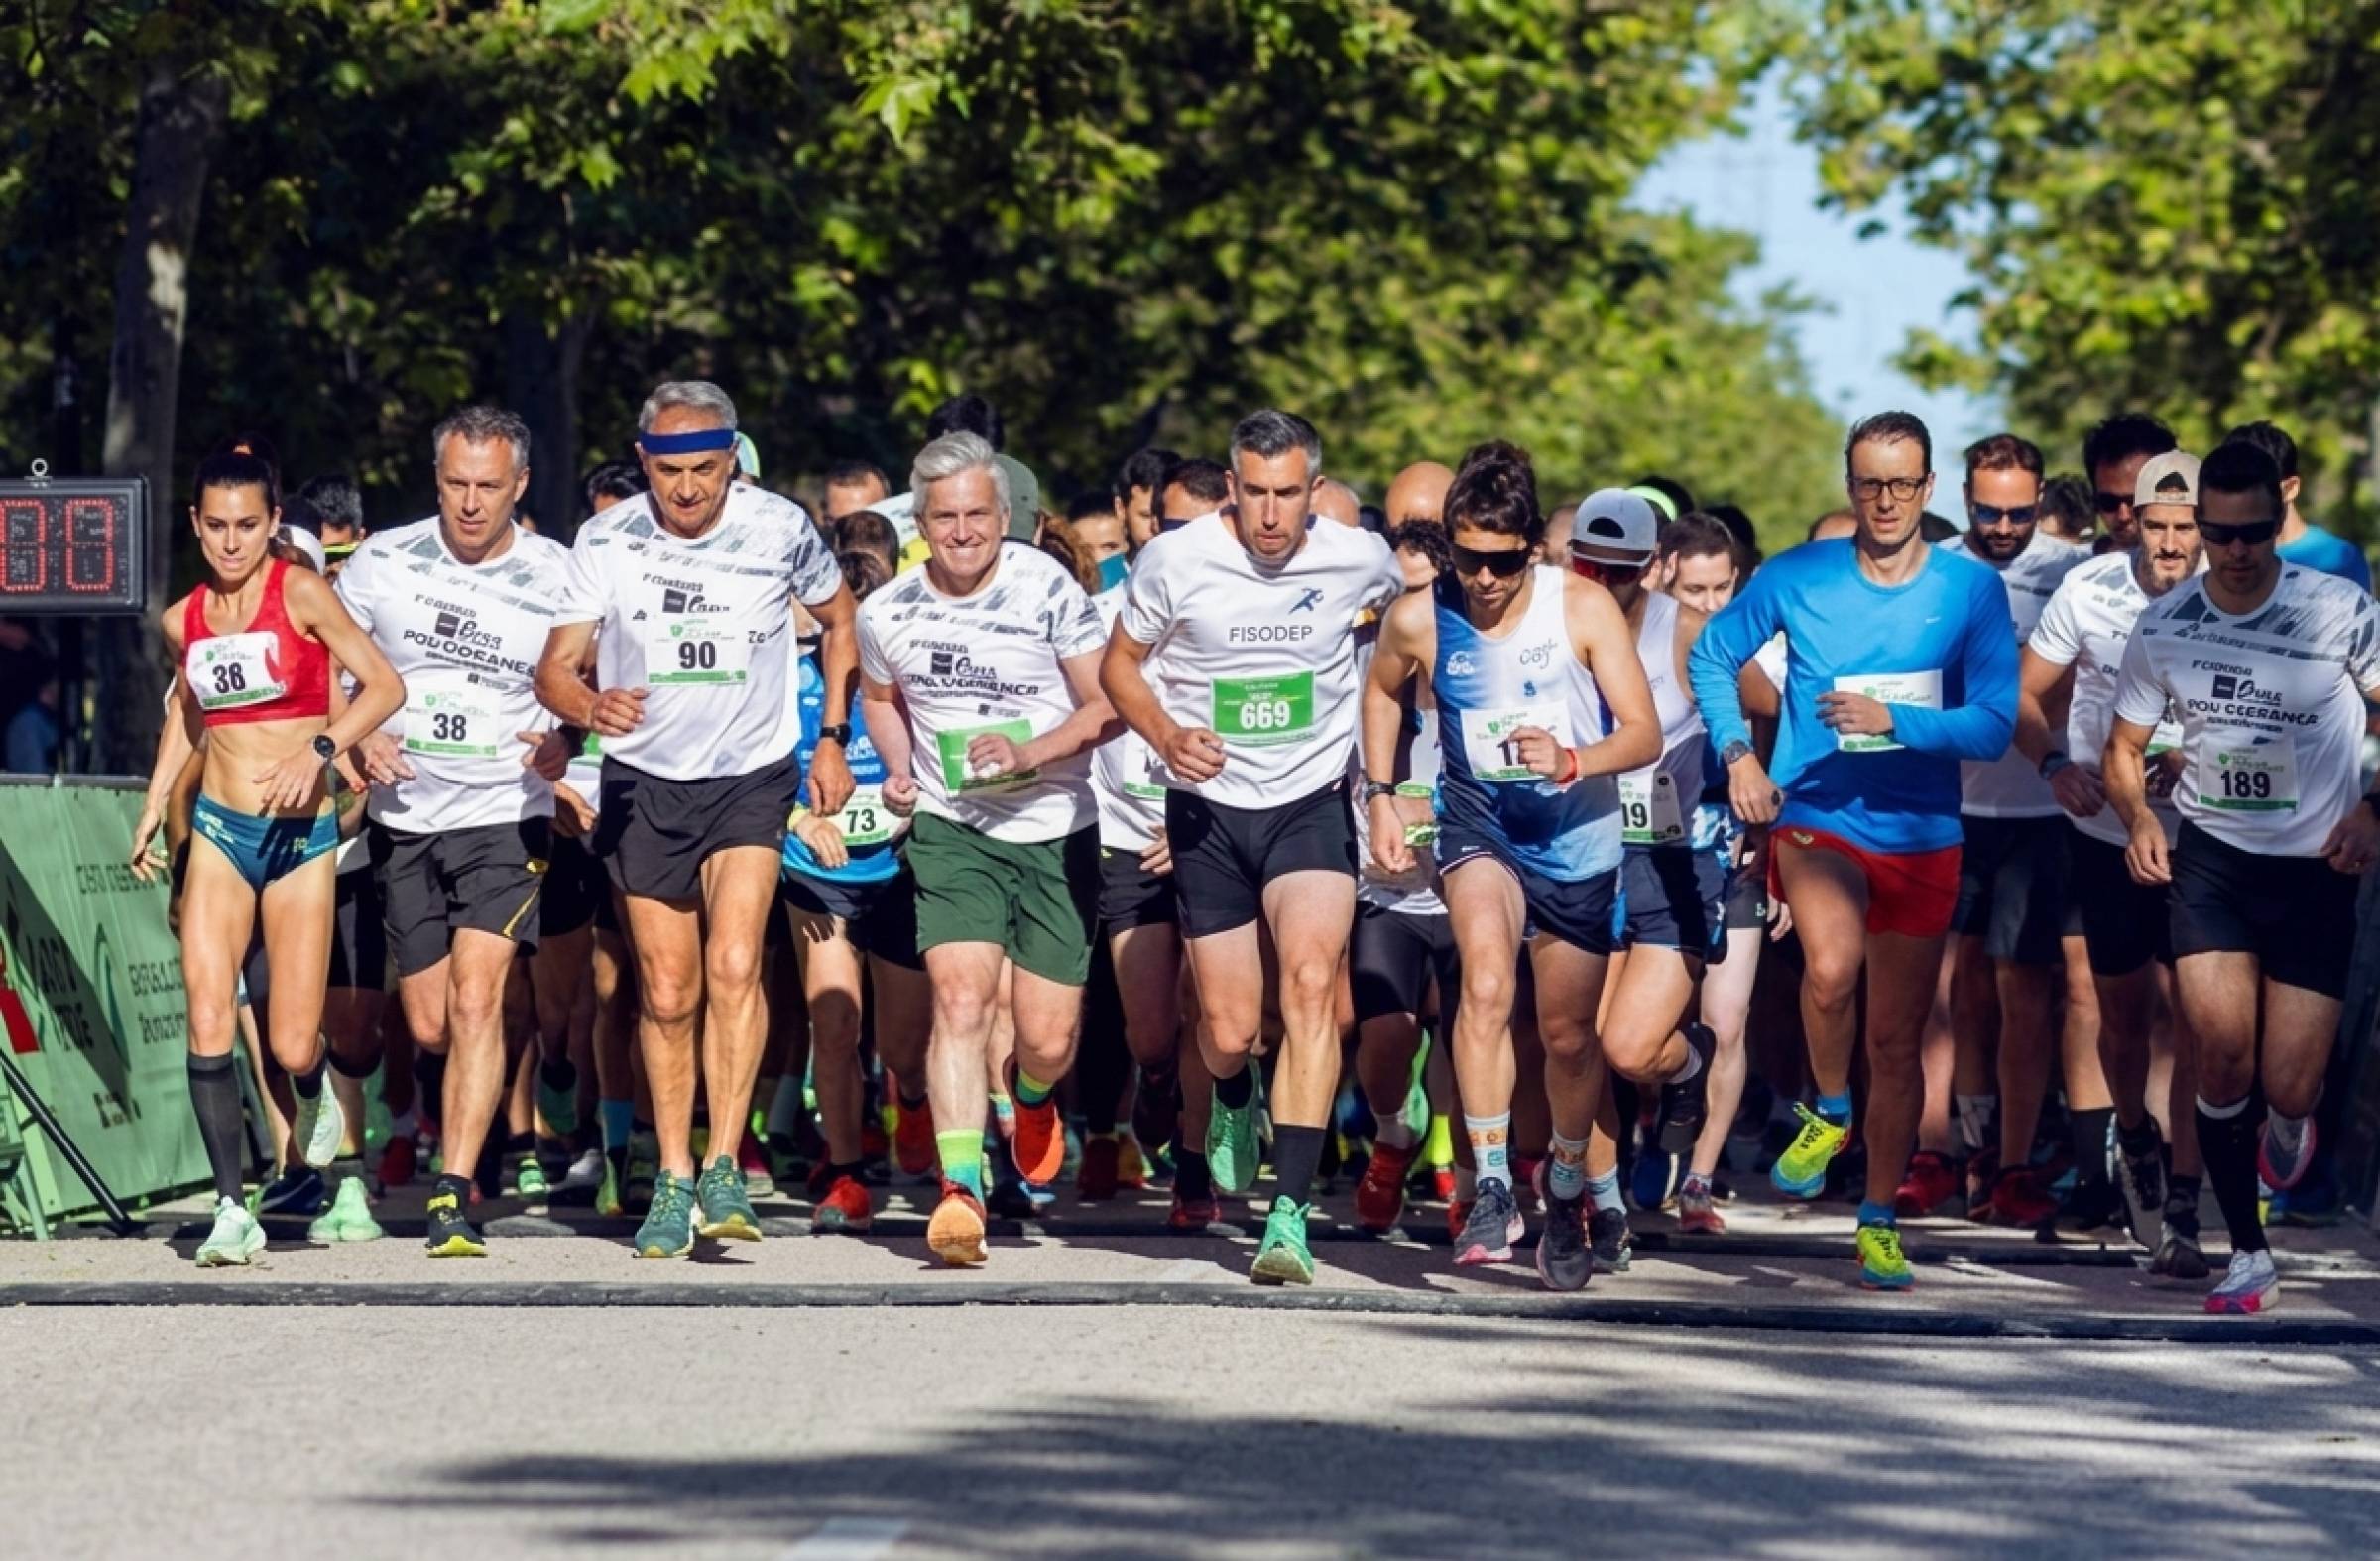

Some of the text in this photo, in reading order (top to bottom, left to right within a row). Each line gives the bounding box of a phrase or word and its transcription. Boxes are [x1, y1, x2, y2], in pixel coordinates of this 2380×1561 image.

[1229, 625, 1313, 643] FISODEP
[678, 641, 716, 670] 90
[212, 661, 246, 694] 38
[433, 712, 467, 742] 38
[1239, 700, 1292, 730] 669
[2220, 769, 2271, 798] 189
[846, 808, 877, 834] 73
